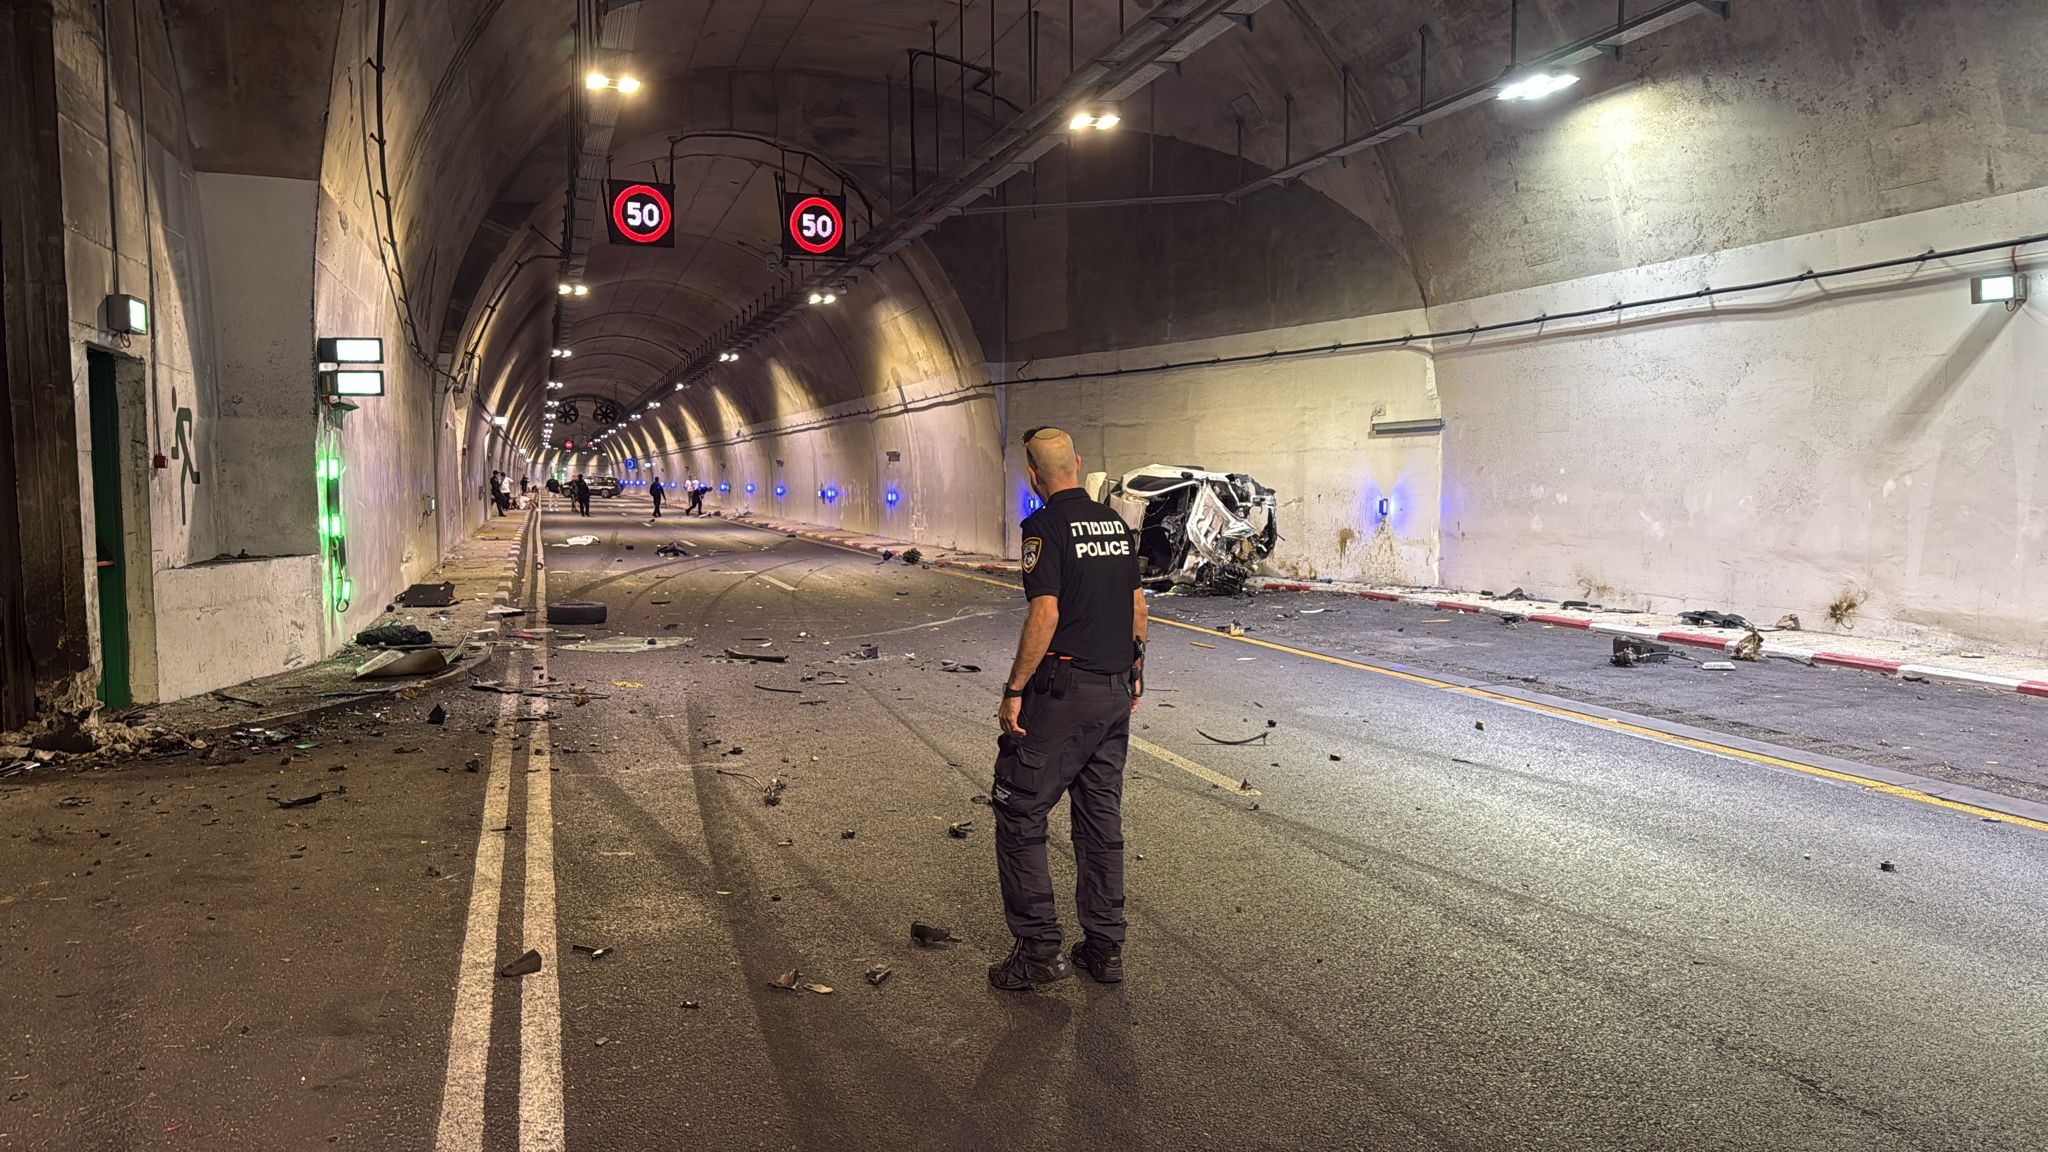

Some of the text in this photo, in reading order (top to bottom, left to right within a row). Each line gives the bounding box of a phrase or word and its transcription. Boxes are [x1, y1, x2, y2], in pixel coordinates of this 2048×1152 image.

[627, 202, 660, 227] 50
[802, 213, 833, 238] 50
[1070, 520, 1126, 538] משטרה
[1075, 540, 1130, 559] POLICE
